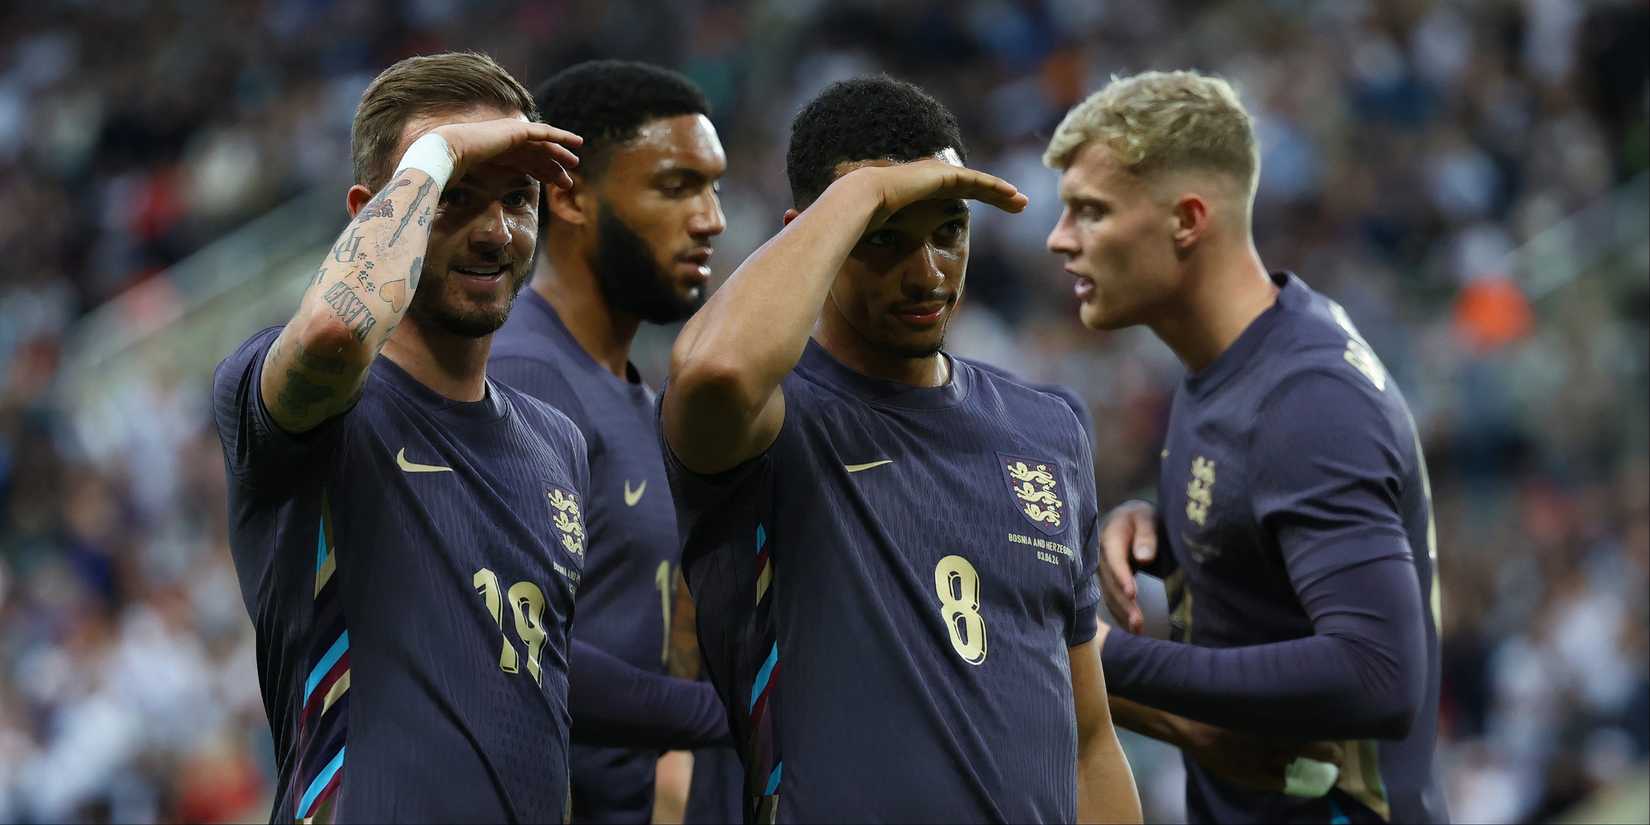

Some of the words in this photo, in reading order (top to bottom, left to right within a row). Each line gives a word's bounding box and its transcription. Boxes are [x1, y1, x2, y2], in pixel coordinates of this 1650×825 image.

[1008, 533, 1032, 546] BOSNIA
[1033, 538, 1046, 549] AND
[473, 567, 547, 688] 19
[934, 555, 988, 666] 8
